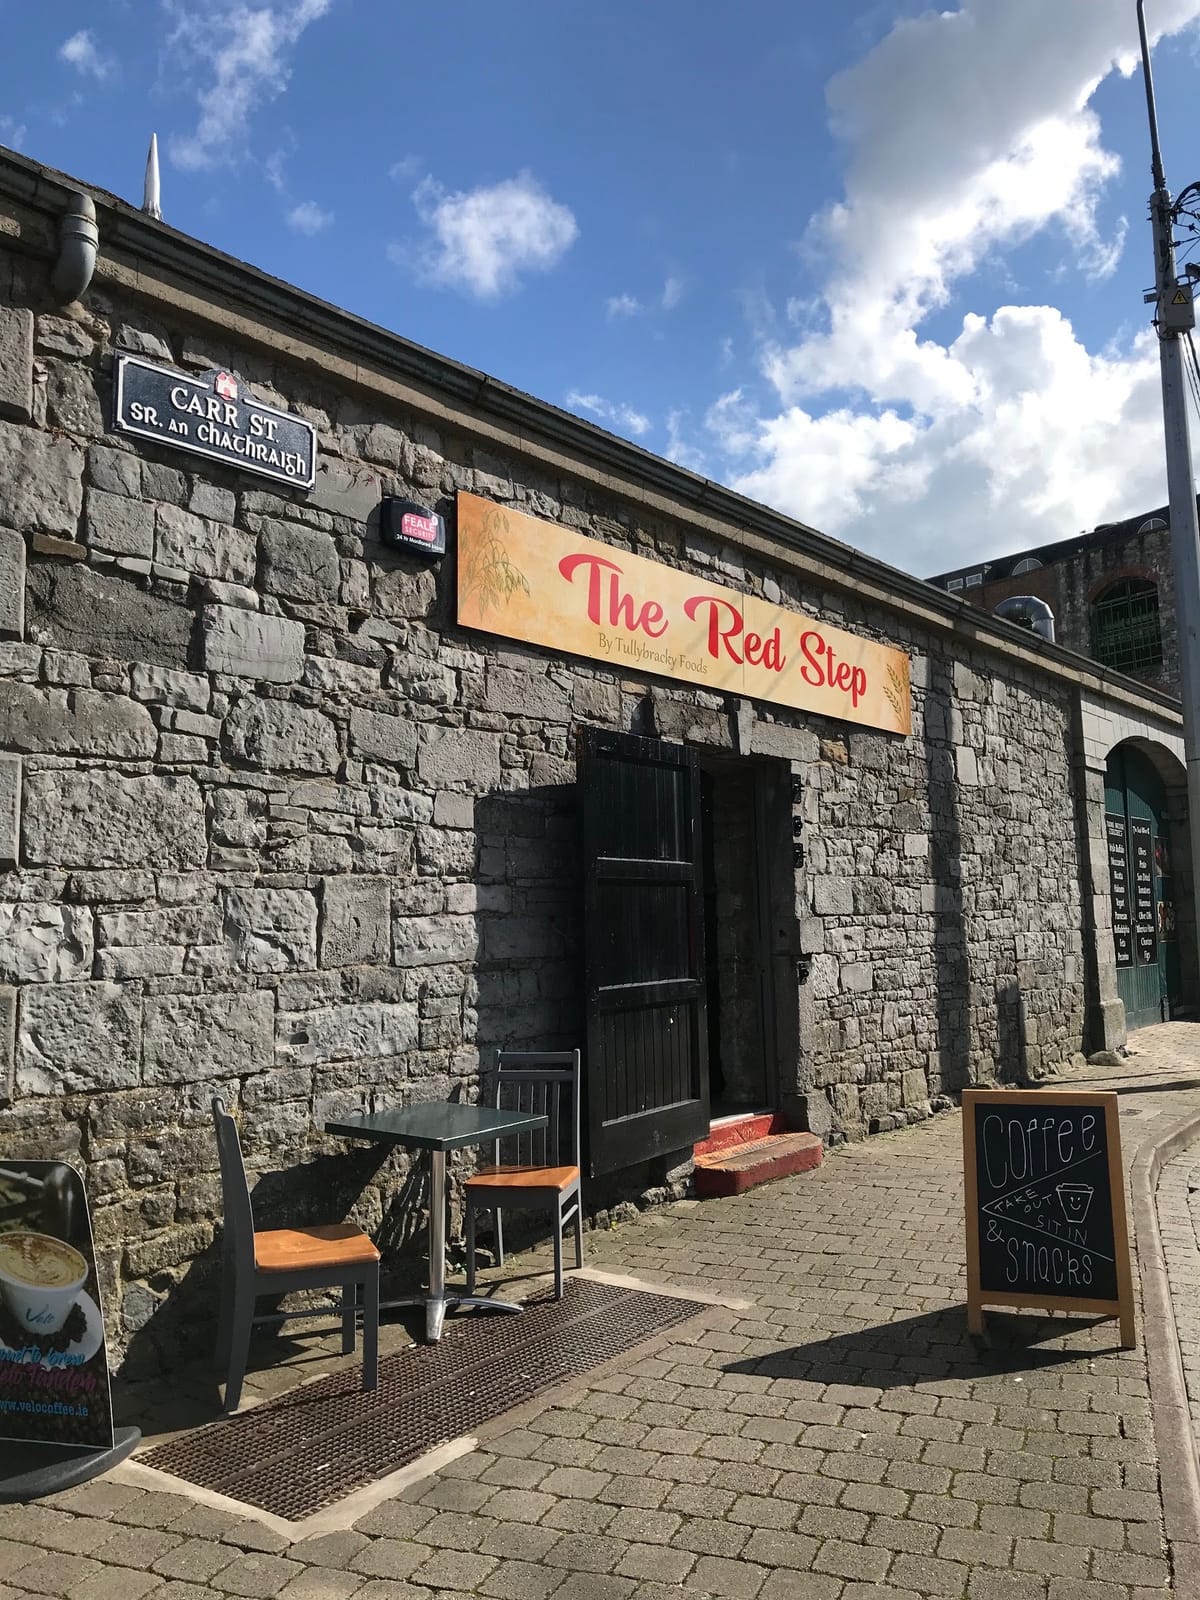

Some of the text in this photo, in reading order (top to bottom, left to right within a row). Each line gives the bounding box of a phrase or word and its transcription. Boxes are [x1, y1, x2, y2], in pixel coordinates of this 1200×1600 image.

[171, 386, 280, 444] CARR ST.
[404, 515, 435, 533] FEALE
[558, 553, 867, 708] The Red Step
[598, 632, 708, 674] By Tullybracky Foods
[994, 1188, 1039, 1212] TAKE
[1024, 1193, 1053, 1214] OUT
[986, 1220, 1005, 1243] &
[1036, 1214, 1088, 1245] SIT IN
